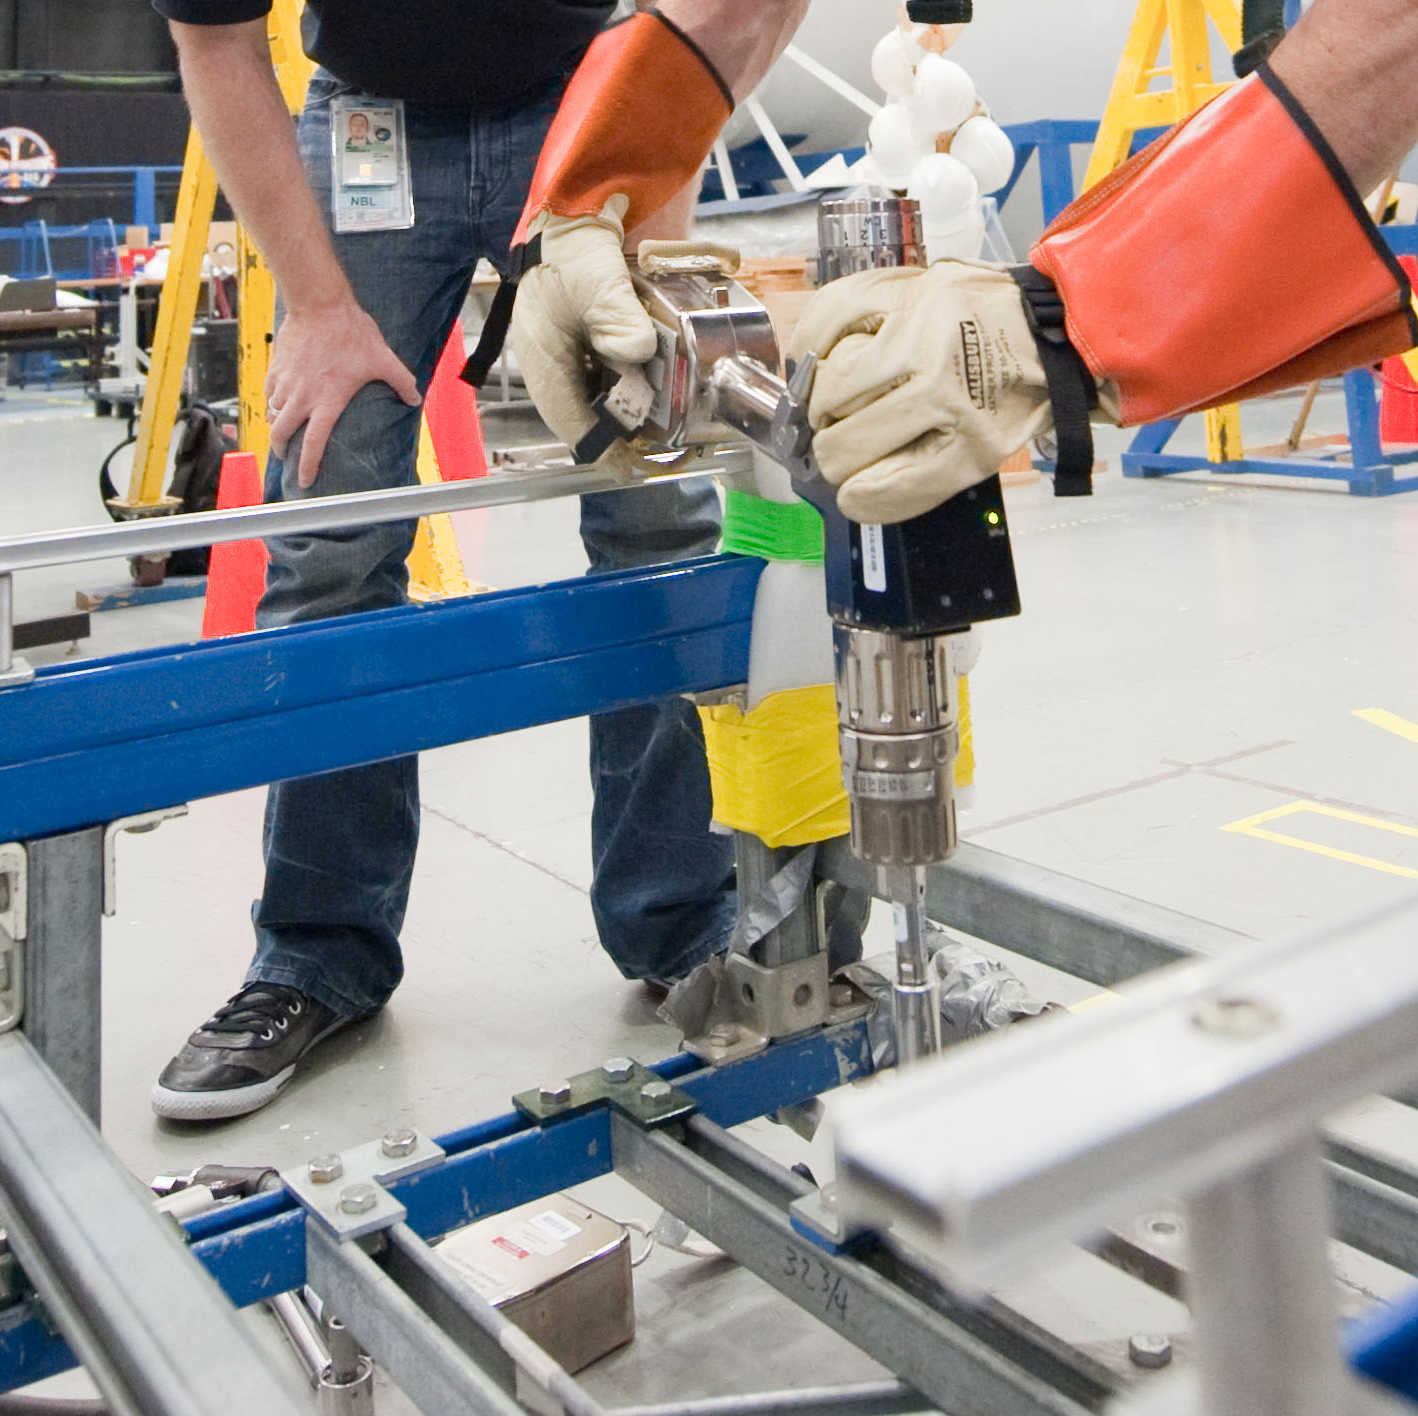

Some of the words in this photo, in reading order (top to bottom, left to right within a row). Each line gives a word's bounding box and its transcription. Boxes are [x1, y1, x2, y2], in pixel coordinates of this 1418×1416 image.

[350, 196, 377, 206] NBL
[860, 229, 868, 240] 2
[879, 228, 887, 240] 3
[961, 322, 984, 409] SALISBURY
